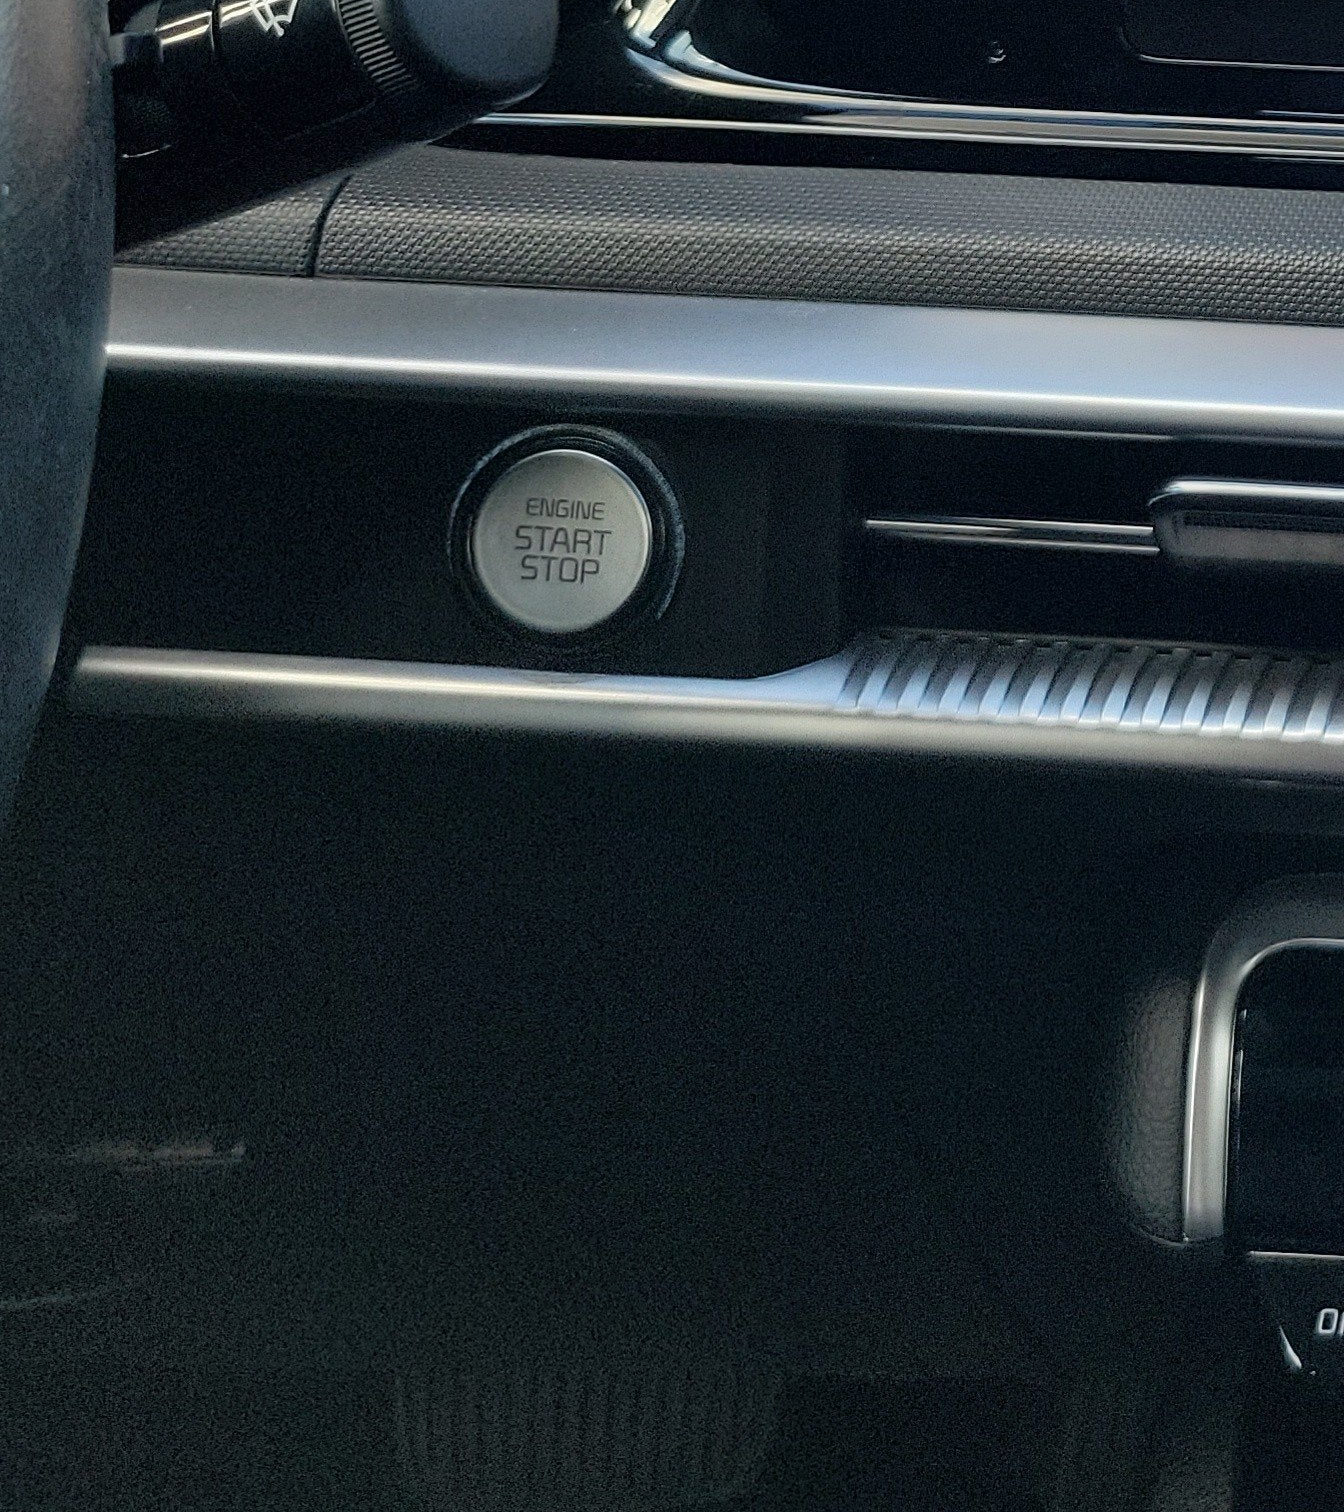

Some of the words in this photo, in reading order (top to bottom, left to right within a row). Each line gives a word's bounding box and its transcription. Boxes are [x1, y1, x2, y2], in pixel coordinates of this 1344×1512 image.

[525, 497, 606, 521] ENGINE
[514, 525, 612, 556] START
[521, 555, 600, 585] STOP
